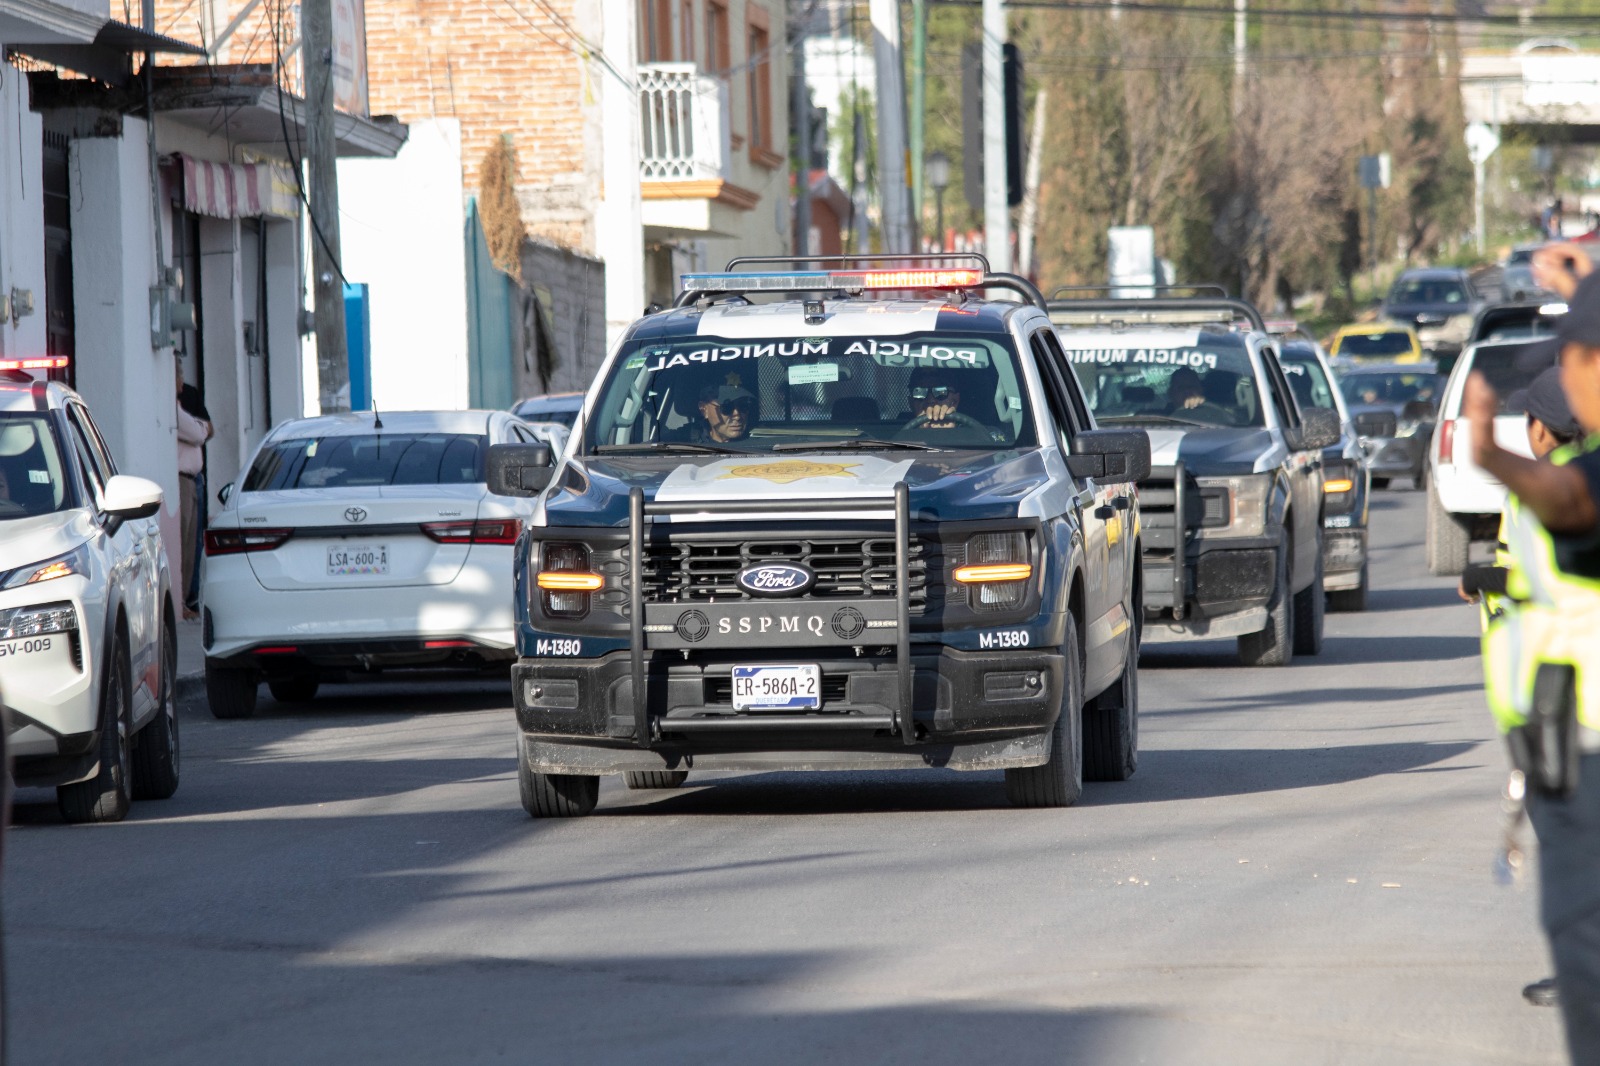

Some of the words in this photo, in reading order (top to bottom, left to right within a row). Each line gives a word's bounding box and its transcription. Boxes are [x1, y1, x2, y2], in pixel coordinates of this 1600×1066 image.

[329, 552, 387, 566] LSA-600-A
[753, 569, 795, 587] Ford
[536, 638, 581, 656] M-1380
[979, 630, 1029, 649] M-1380
[736, 677, 815, 696] ER-586A-2
